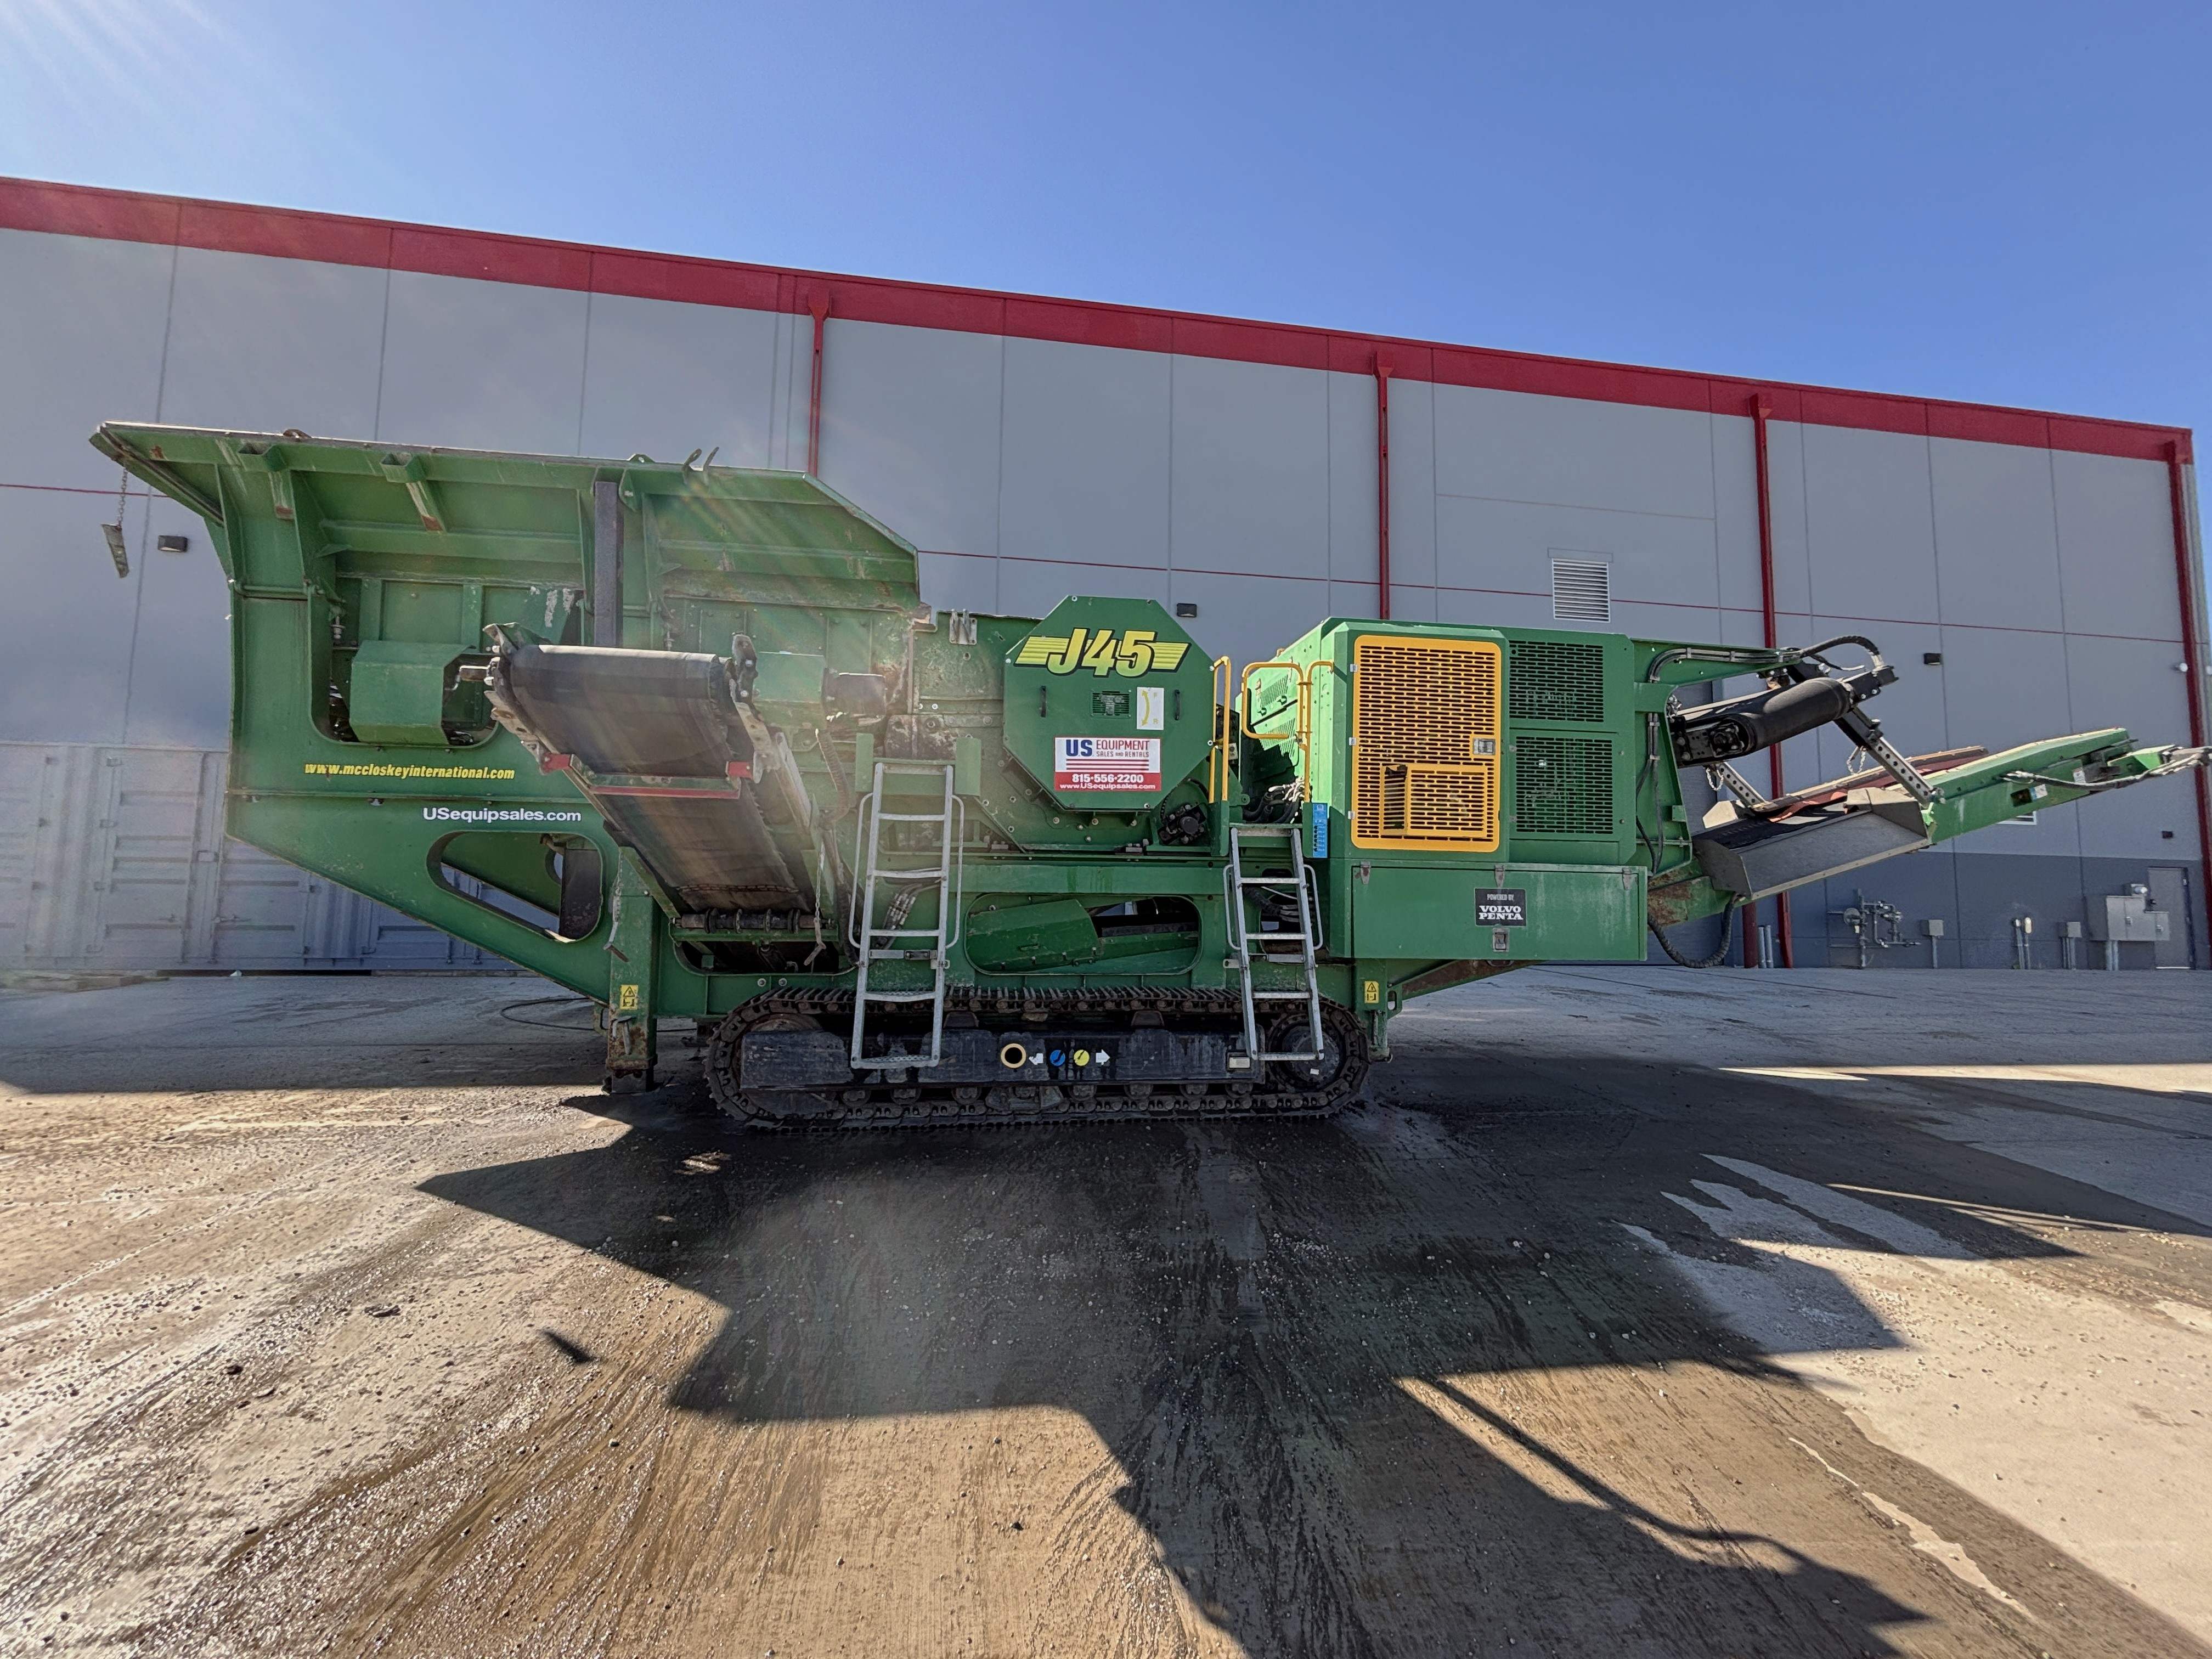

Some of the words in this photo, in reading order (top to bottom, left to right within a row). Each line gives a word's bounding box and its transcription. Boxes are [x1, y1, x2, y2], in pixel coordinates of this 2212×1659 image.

[1047, 628, 1156, 678] J45
[1096, 740, 1150, 751] EQUIPMENT
[304, 763, 515, 780] www.mccloskeyinternational.com
[423, 808, 582, 823] USequipsales.com
